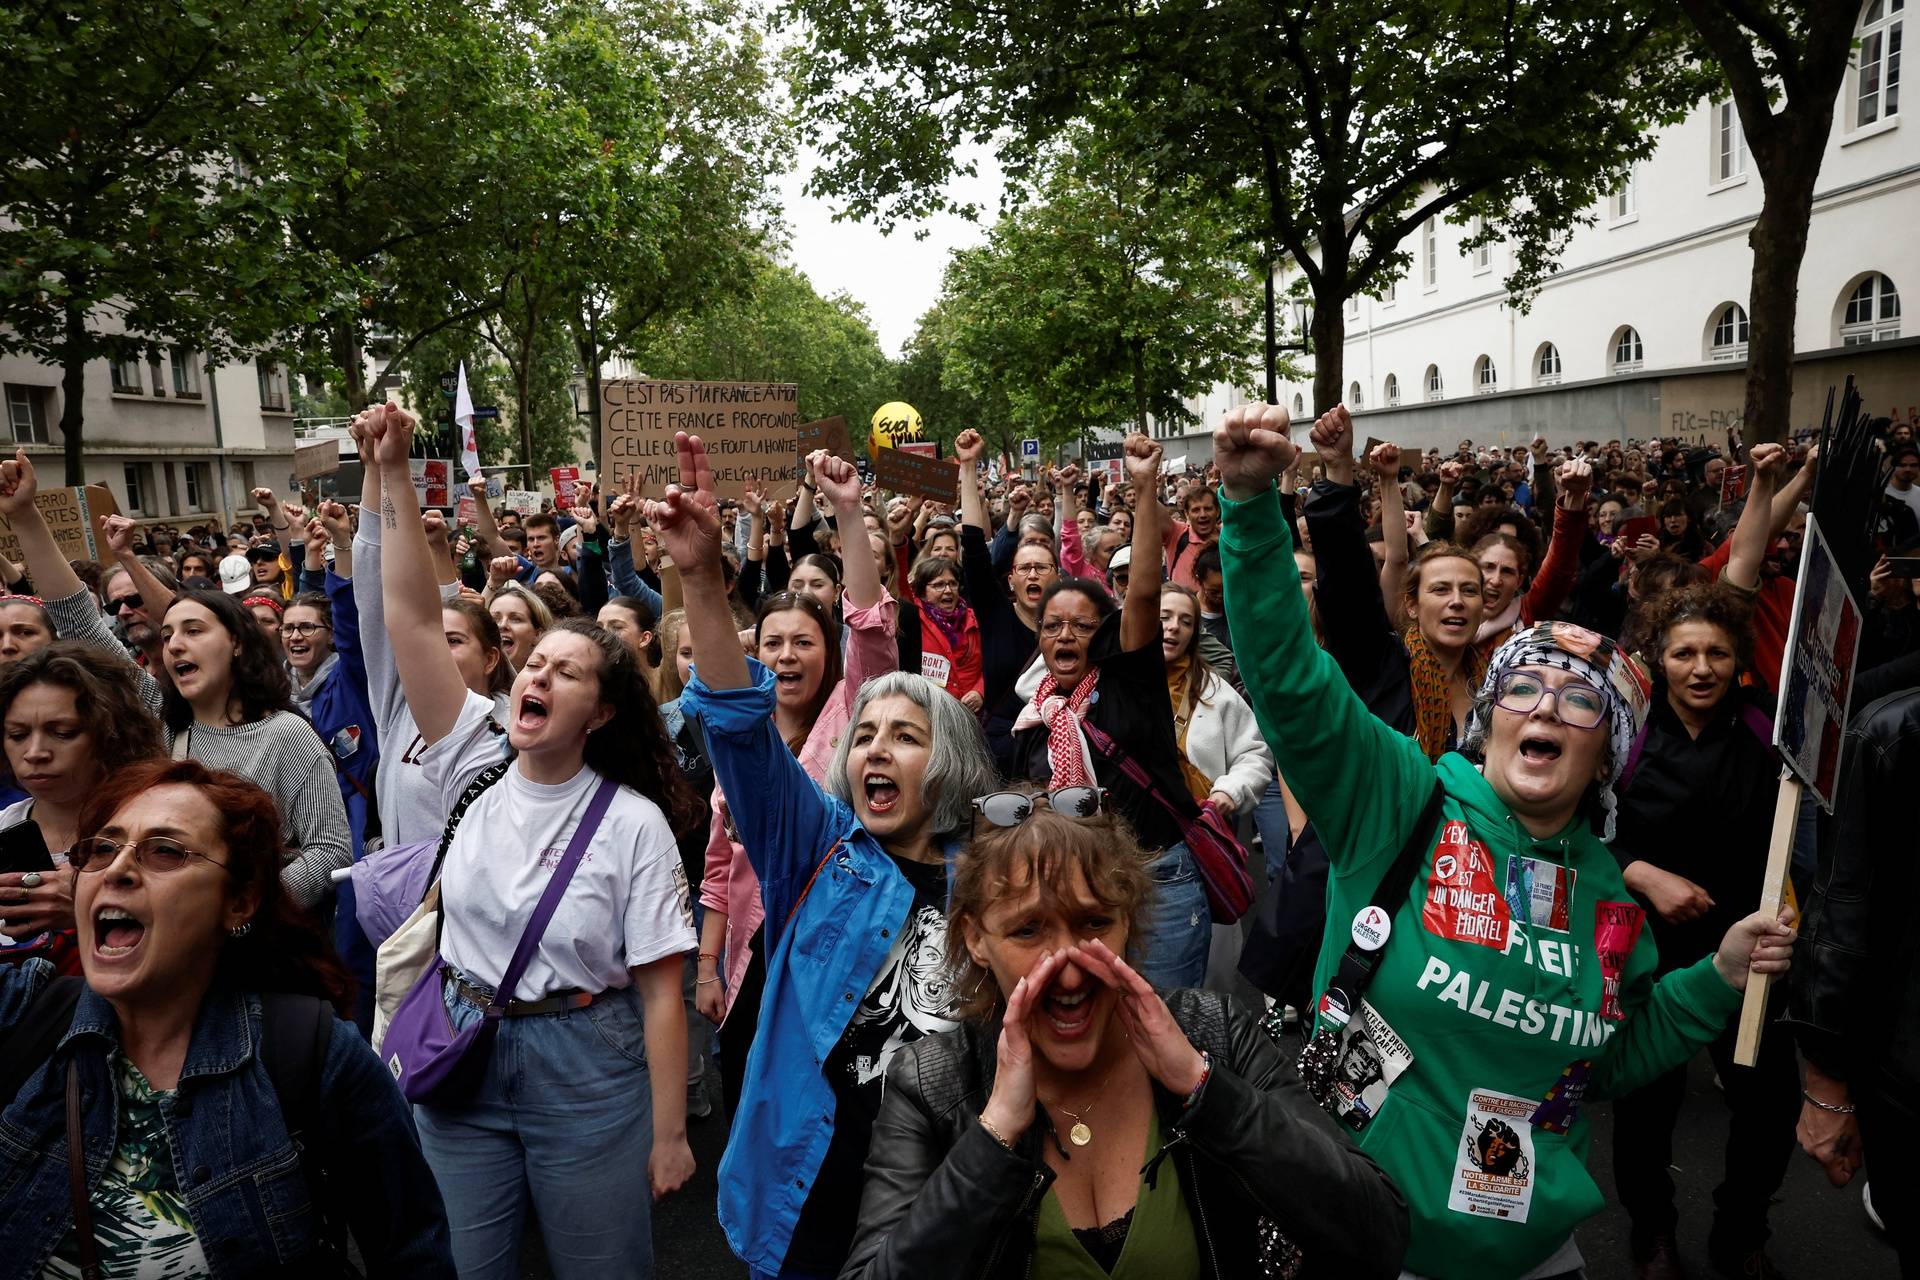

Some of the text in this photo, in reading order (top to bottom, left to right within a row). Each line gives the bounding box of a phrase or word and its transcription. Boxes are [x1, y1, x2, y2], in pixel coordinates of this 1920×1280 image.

[442, 377, 457, 387] BUS
[603, 379, 654, 406] C'EST
[660, 384, 685, 404] PAS
[608, 409, 798, 432] CETTE FRANCE PROFONDE
[611, 436, 660, 457] CELLE
[721, 439, 748, 454] FOUT
[764, 438, 797, 455] HONTE
[1027, 443, 1034, 453] P
[613, 462, 641, 485] ET
[761, 465, 797, 482] PLONGE
[34, 493, 67, 509] ERRO
[922, 656, 944, 670] RONT
[922, 669, 947, 680] ULAIRE
[1459, 871, 1475, 888] EST
[1433, 885, 1497, 916] UN DANGER
[1357, 921, 1381, 939] URGENCE
[1455, 911, 1502, 942] MORTEL
[1353, 926, 1379, 946] PALESTINE
[1375, 1034, 1397, 1058] PARLE
[1389, 1033, 1412, 1062] DROITE
[1474, 1095, 1500, 1105] CONTRE
[1509, 1101, 1538, 1112] RACISME
[1496, 1107, 1526, 1117] FASCISME
[1462, 1170, 1489, 1181] NOTRE
[1490, 1175, 1512, 1185] ARME
[1467, 1181, 1521, 1195] LA SOLIDARITÉ
